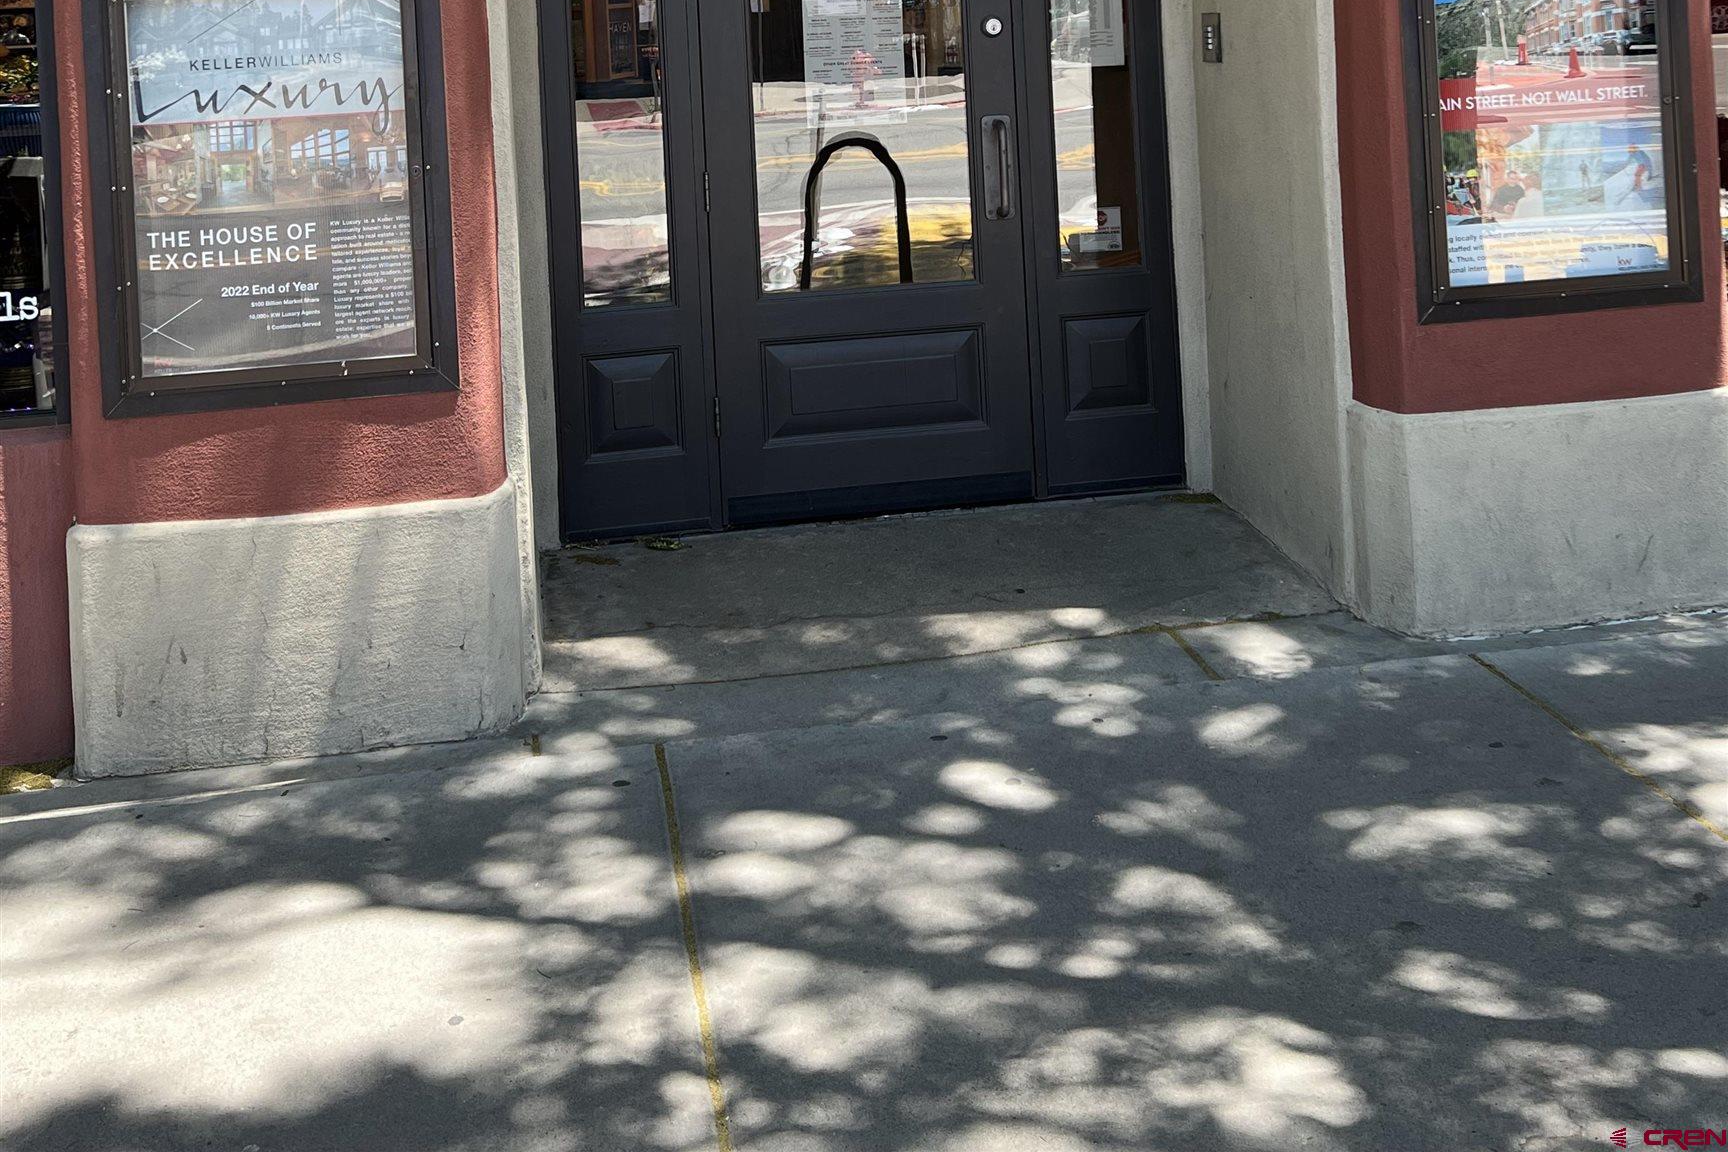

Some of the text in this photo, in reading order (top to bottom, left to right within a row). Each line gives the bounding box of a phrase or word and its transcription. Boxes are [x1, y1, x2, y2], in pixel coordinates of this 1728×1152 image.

[133, 67, 403, 142] Luxury
[1522, 91, 1552, 106] NOT
[1556, 88, 1592, 104] WALL
[146, 222, 316, 248] THE HOUSE OF
[149, 244, 318, 271] EXCELLENCE
[220, 281, 319, 298] 2022 End of Year
